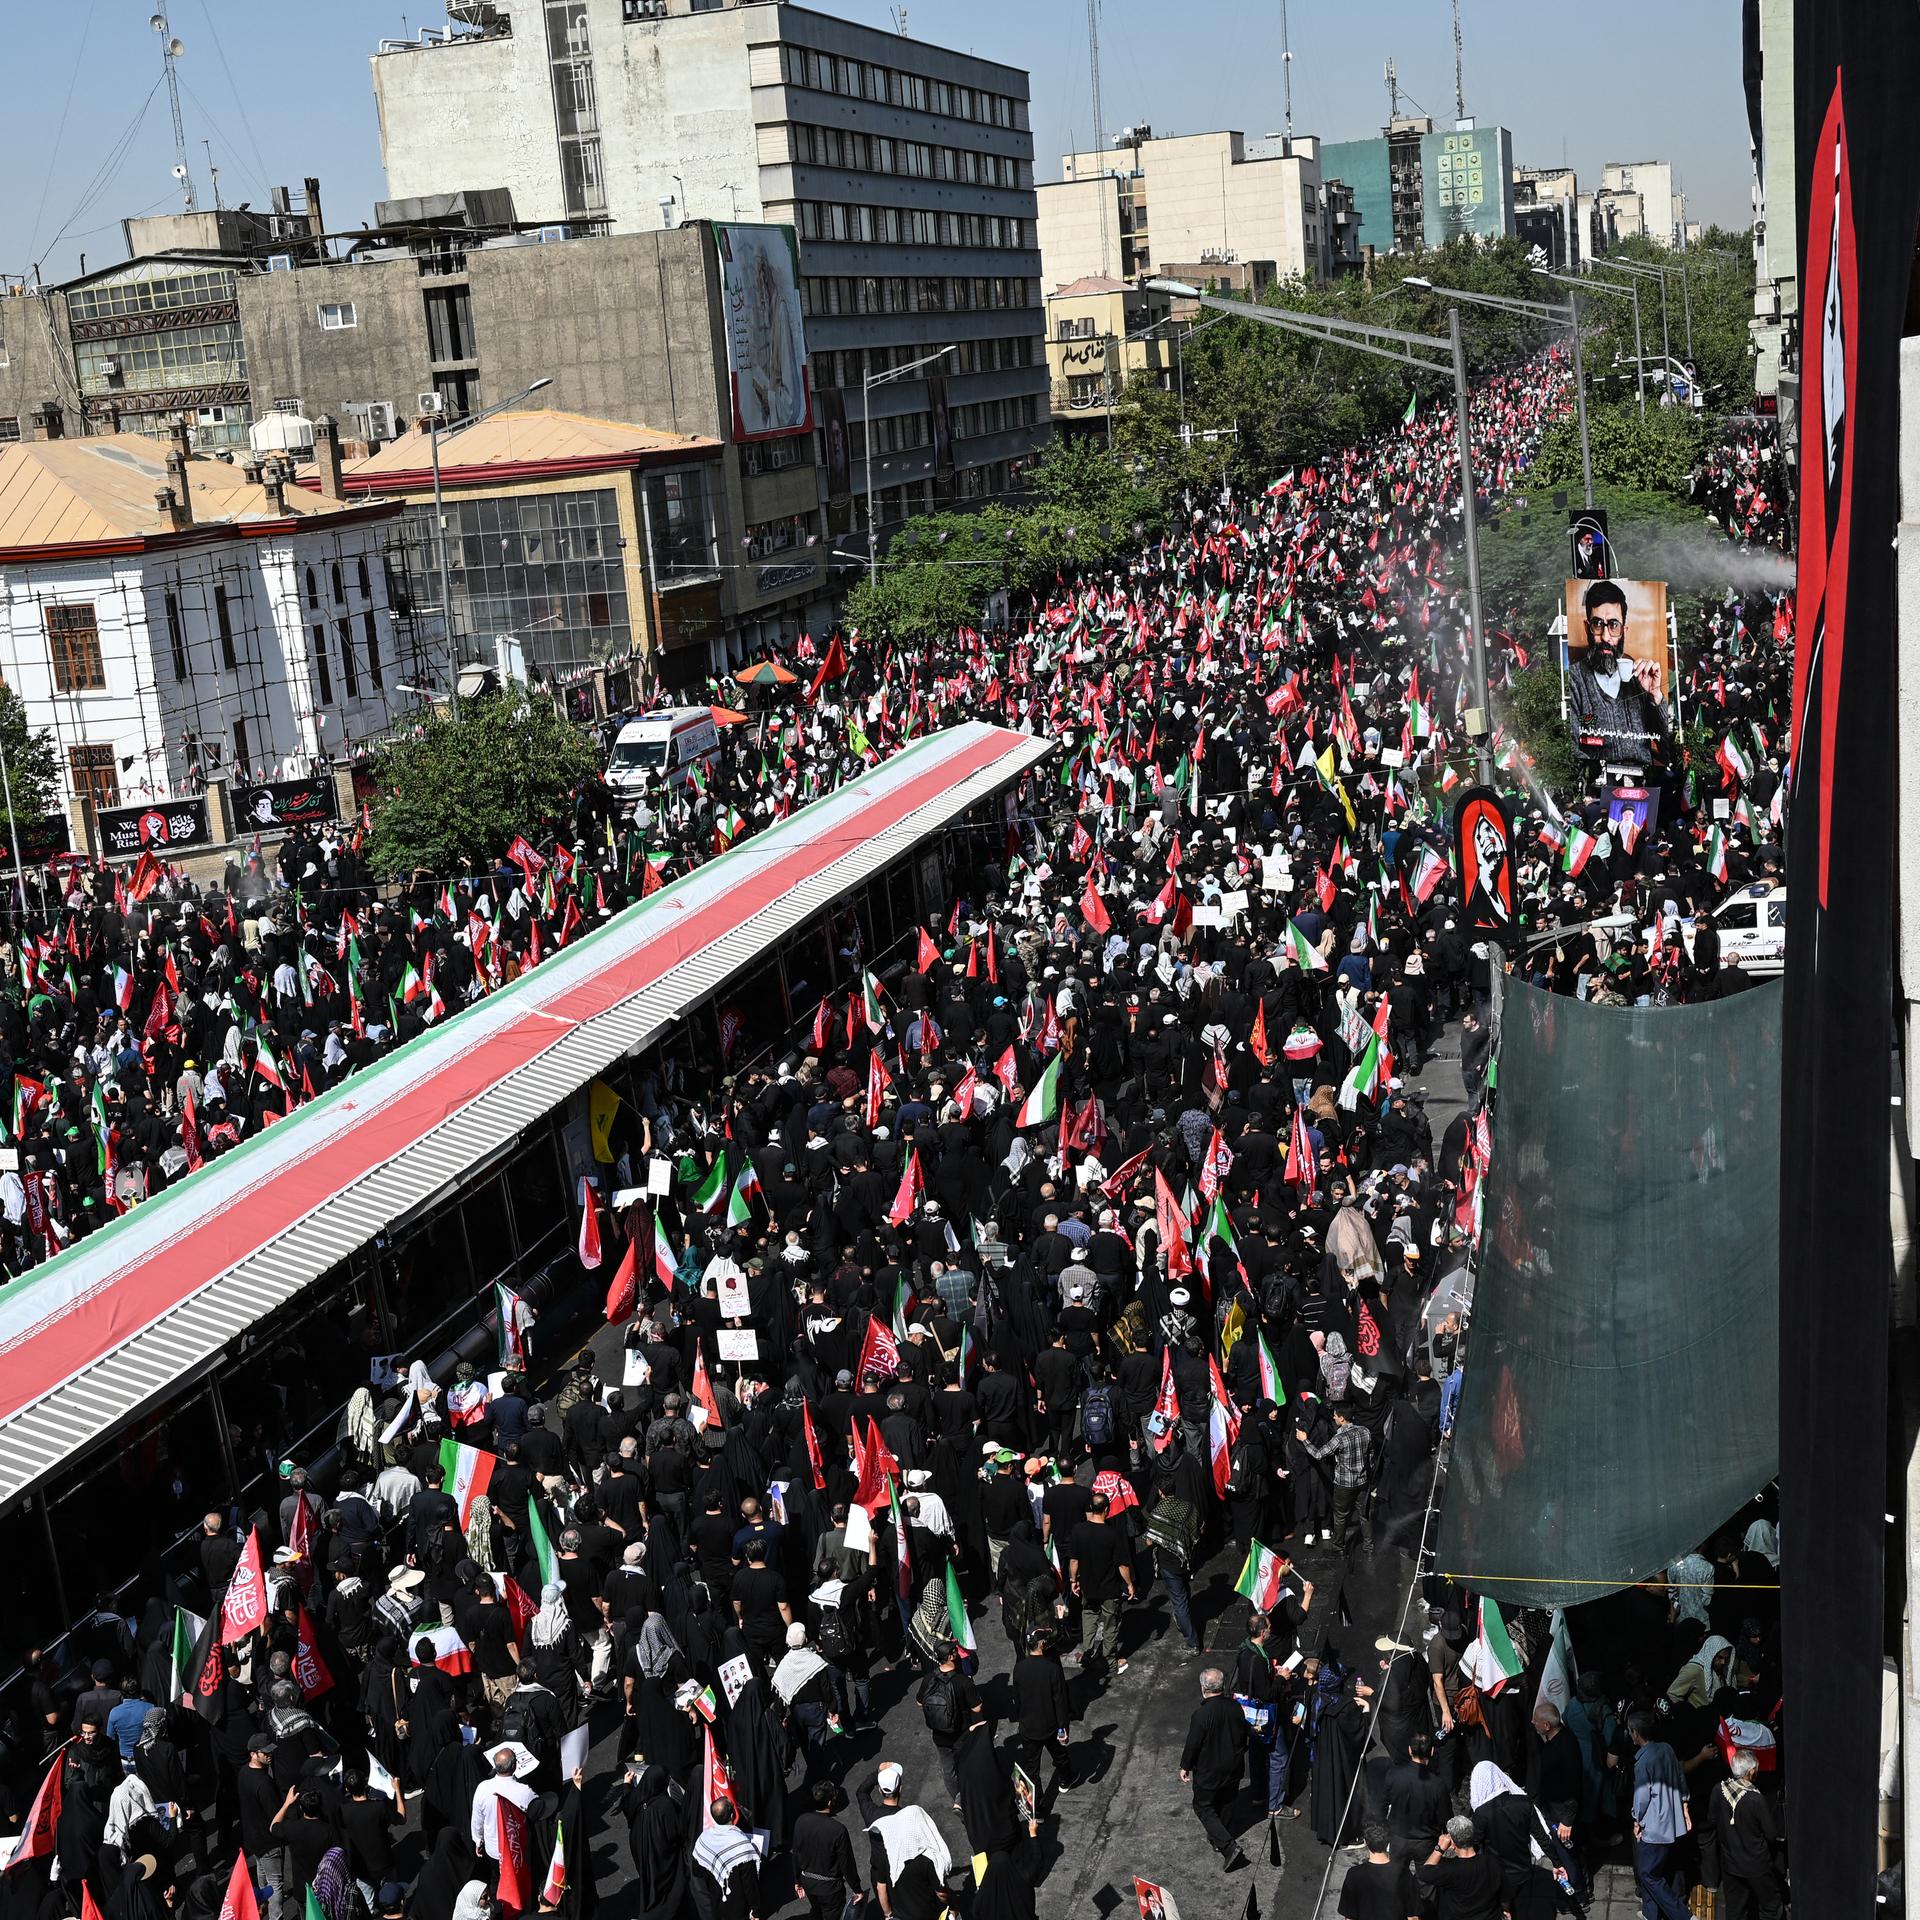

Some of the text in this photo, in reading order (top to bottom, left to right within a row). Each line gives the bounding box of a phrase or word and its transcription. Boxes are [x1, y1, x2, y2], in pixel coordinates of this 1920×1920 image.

[1062, 344, 1079, 375] سالم
[118, 821, 138, 831] We
[110, 831, 139, 841] Must
[116, 839, 140, 849] Rise
